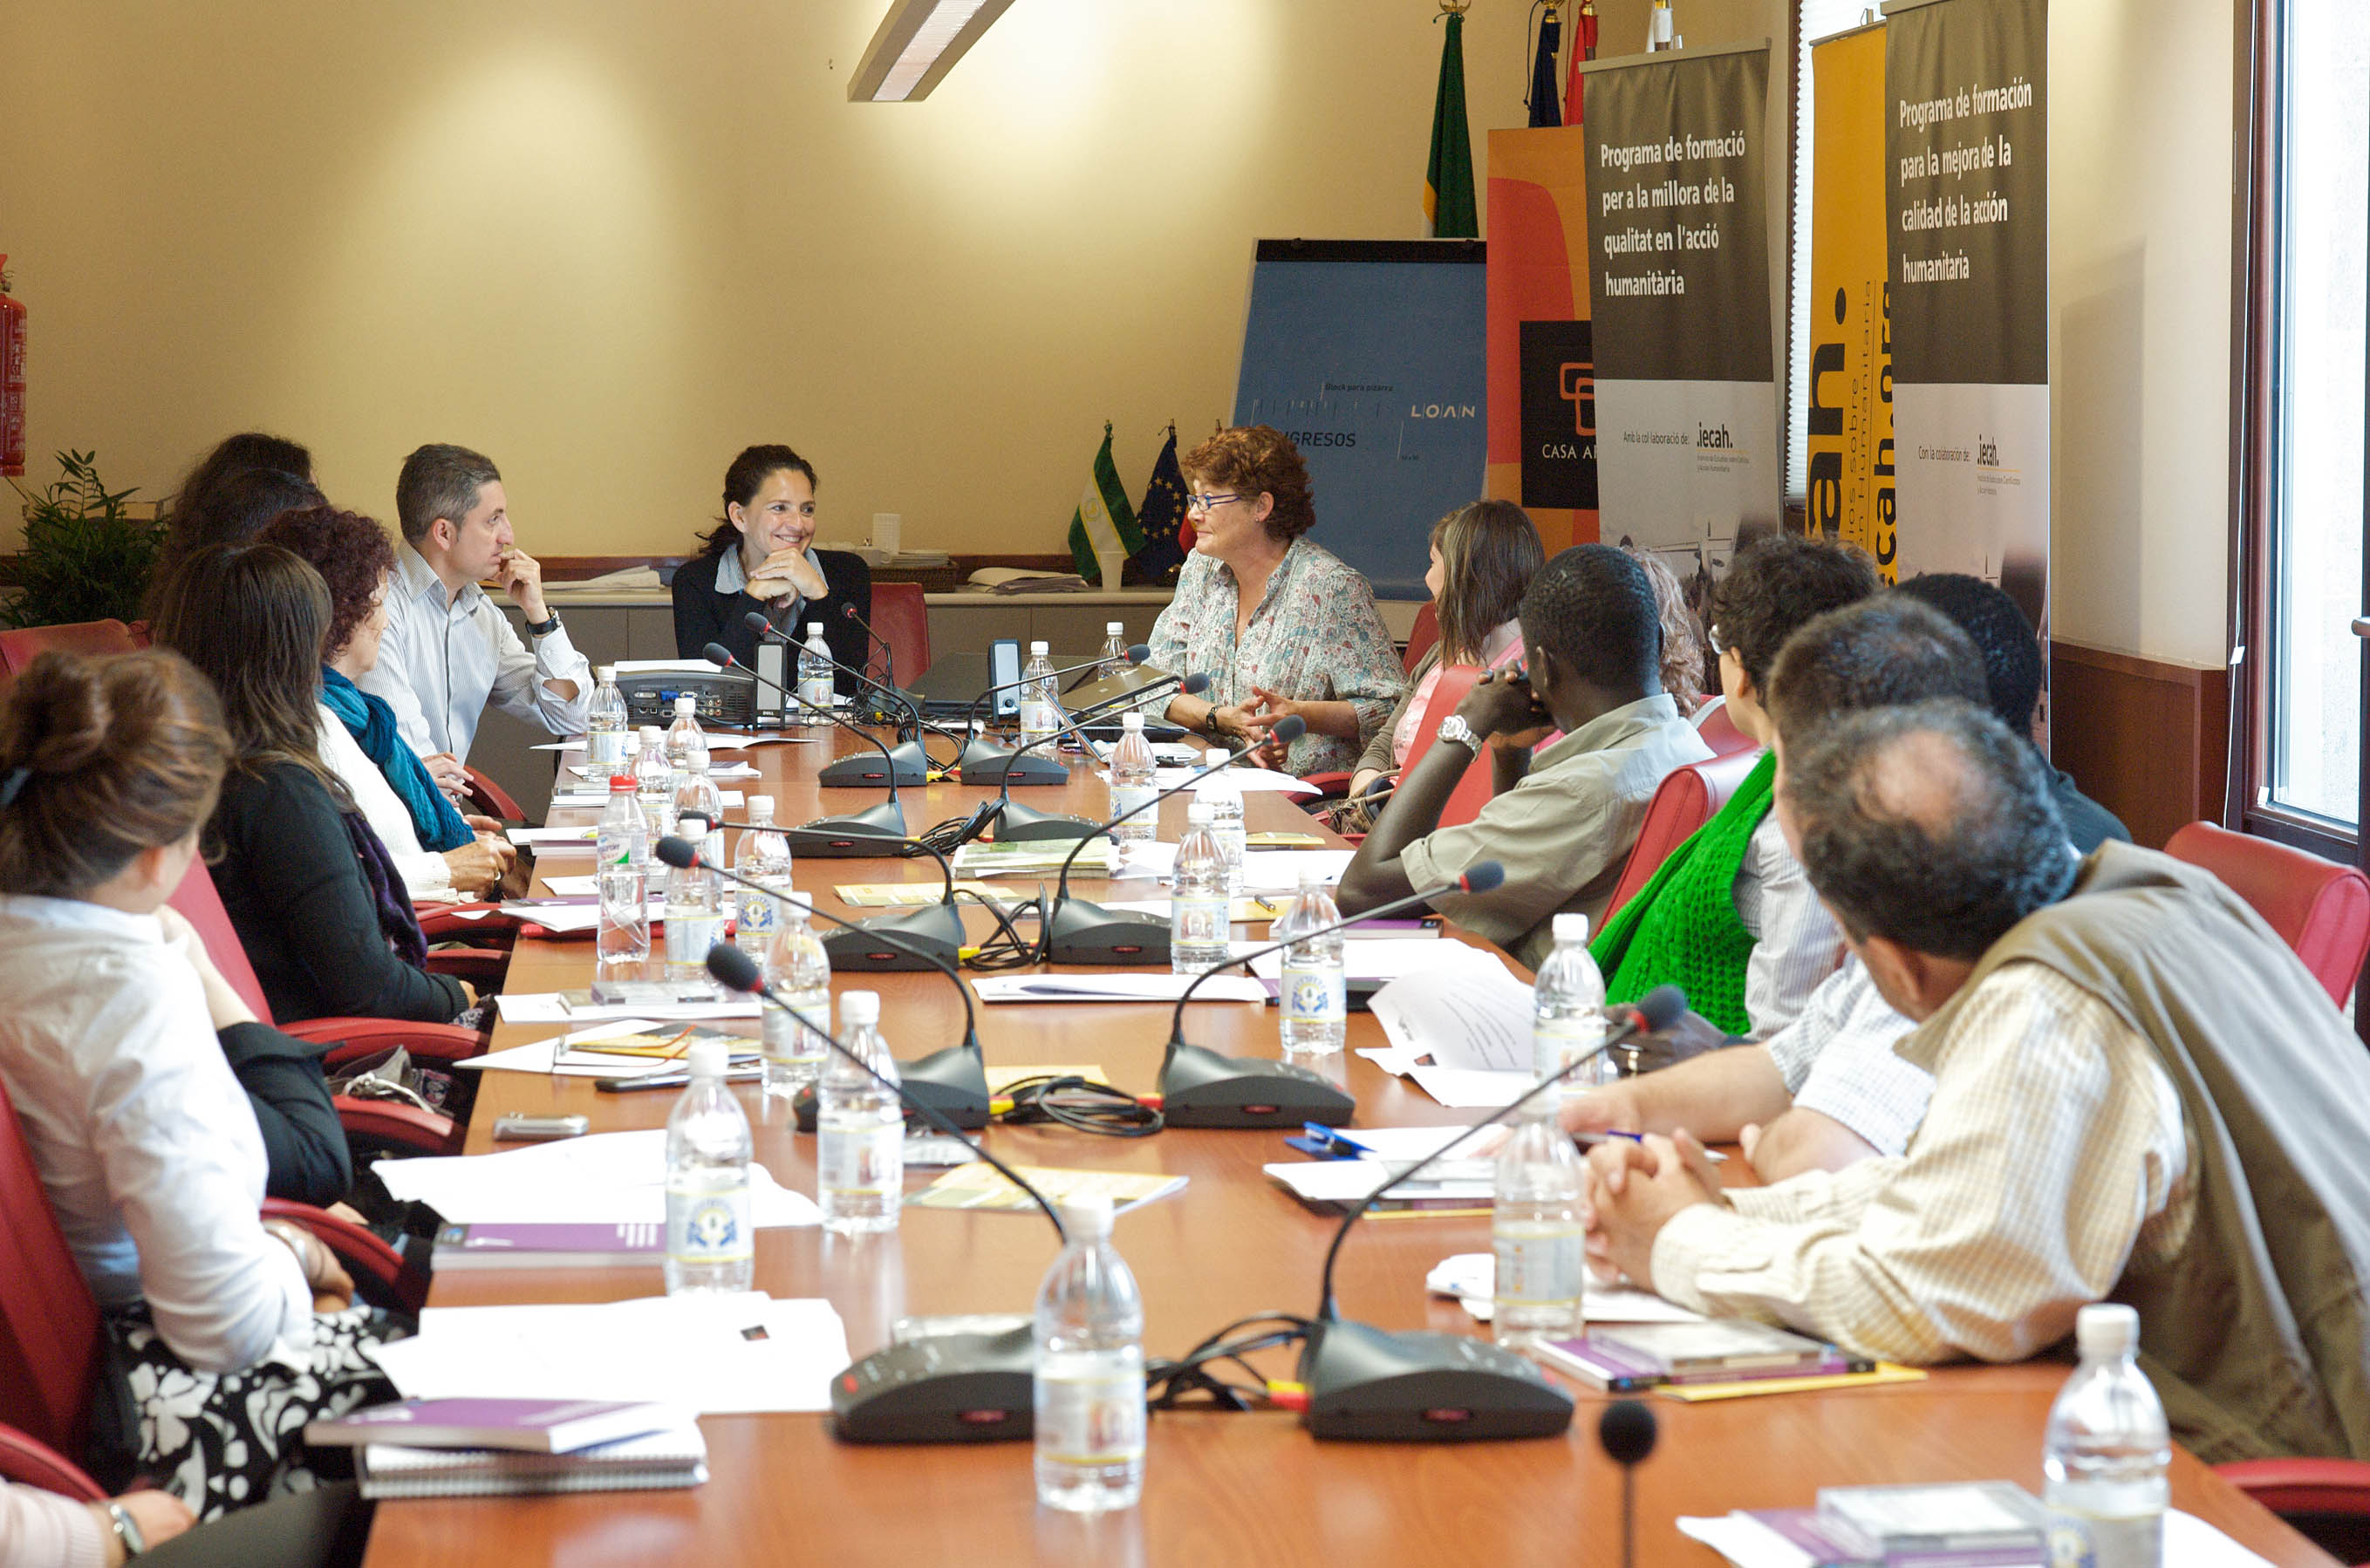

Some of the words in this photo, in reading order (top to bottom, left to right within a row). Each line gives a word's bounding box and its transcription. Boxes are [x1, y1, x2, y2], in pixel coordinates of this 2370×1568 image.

[1899, 97, 1953, 133] Programa
[1956, 86, 1970, 119] de
[1972, 76, 2032, 115] formación
[1600, 143, 1662, 173] Programa
[1664, 135, 1683, 162] de
[1685, 129, 1745, 160] formació
[1900, 154, 1925, 188] para
[1927, 146, 1940, 176] la
[1942, 140, 1980, 181] mejora
[1981, 136, 1995, 169] de
[1998, 133, 2011, 167] la
[1602, 190, 1624, 217] per
[1626, 190, 1635, 210] a
[1636, 182, 1649, 208] la
[1651, 180, 1701, 208] millora
[1704, 177, 1719, 204] de
[1721, 176, 1735, 203] la
[1902, 196, 1943, 232] calidad
[1944, 195, 1957, 228] de
[1960, 194, 1970, 226] la
[1973, 190, 2008, 224] acción
[1603, 227, 1653, 261] qualitat
[1655, 231, 1674, 252] en
[1677, 222, 1719, 250] l'acció
[1605, 269, 1685, 297] humanitària
[1902, 249, 1970, 283] humanitaria
[1623, 431, 1636, 443] Amb
[1848, 378, 1859, 474] sobre
[1541, 443, 1578, 460] CASA
[1918, 446, 1929, 460] Con
[1930, 446, 1936, 460] la
